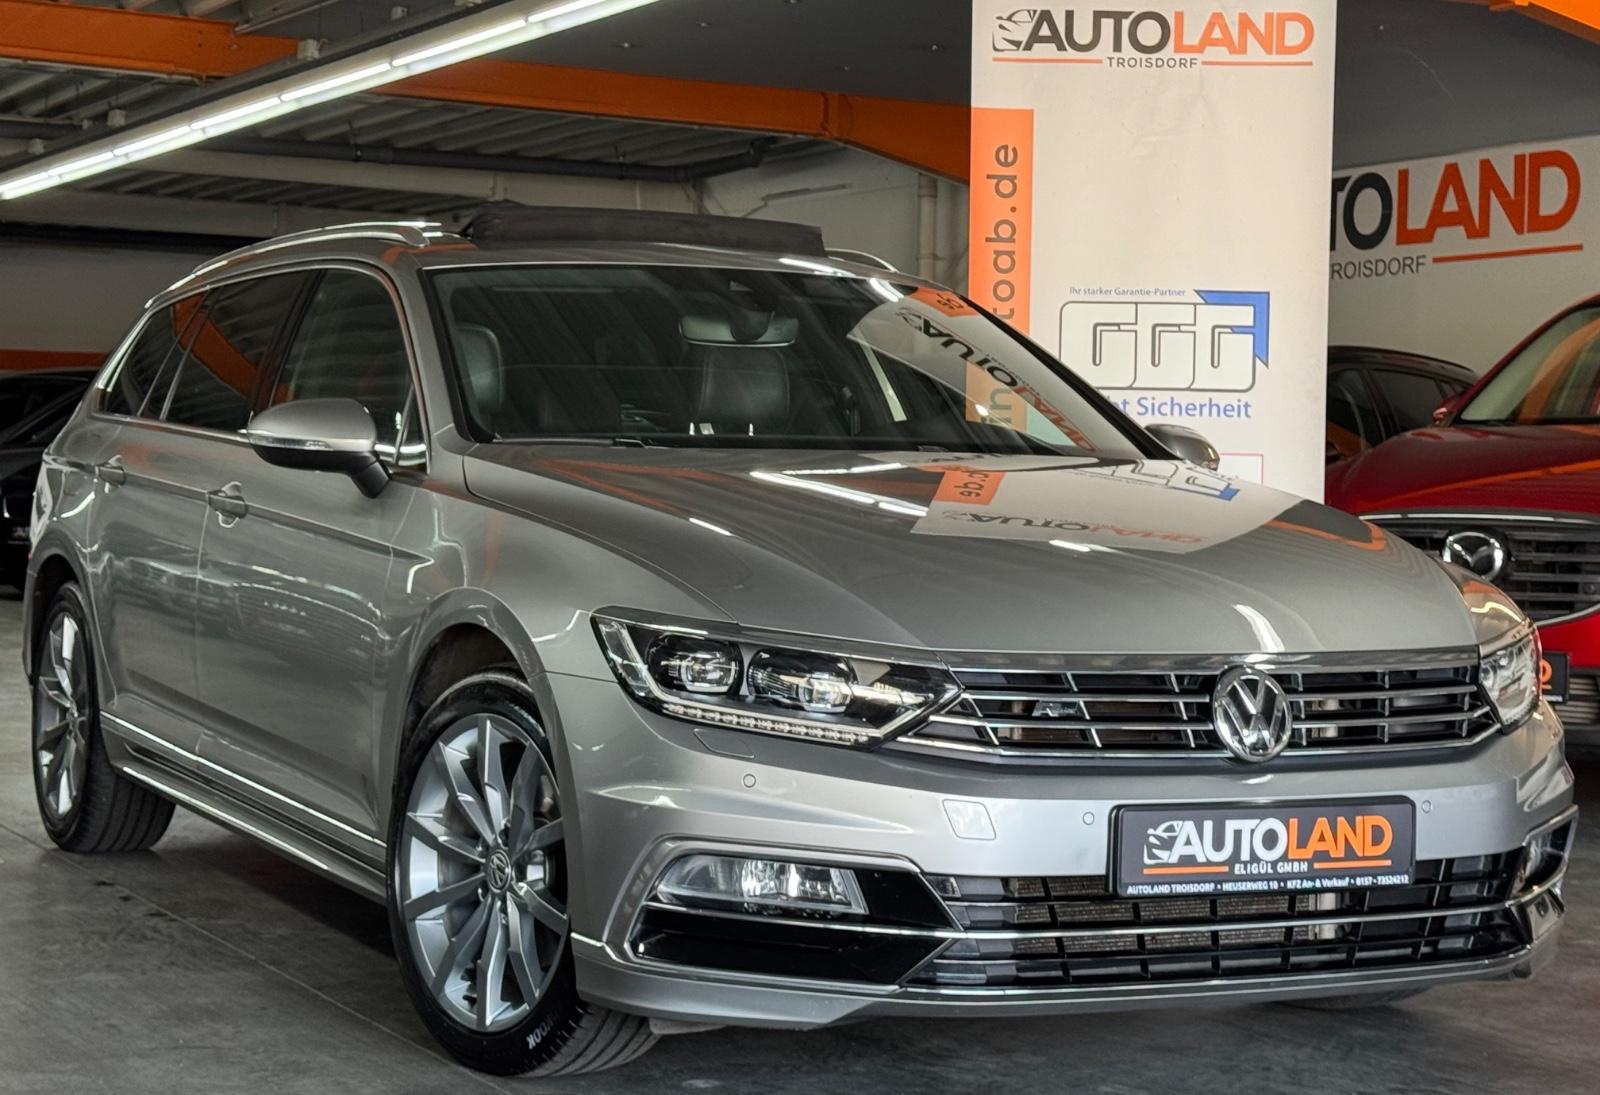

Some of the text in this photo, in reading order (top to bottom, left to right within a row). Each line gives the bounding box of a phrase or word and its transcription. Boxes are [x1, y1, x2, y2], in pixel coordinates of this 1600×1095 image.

[1021, 9, 1315, 56] AUTOLAND
[1106, 56, 1199, 69] TROISDORF
[1331, 255, 1427, 281] ROISDORF
[1069, 287, 1186, 297] Ihr starker Garantie-Partner
[1136, 396, 1251, 418] Sicherheit
[1168, 815, 1393, 864] AUTOLAND
[1234, 860, 1308, 875] ELIGÜL GMBH
[1127, 885, 1170, 895] AUTOLAND
